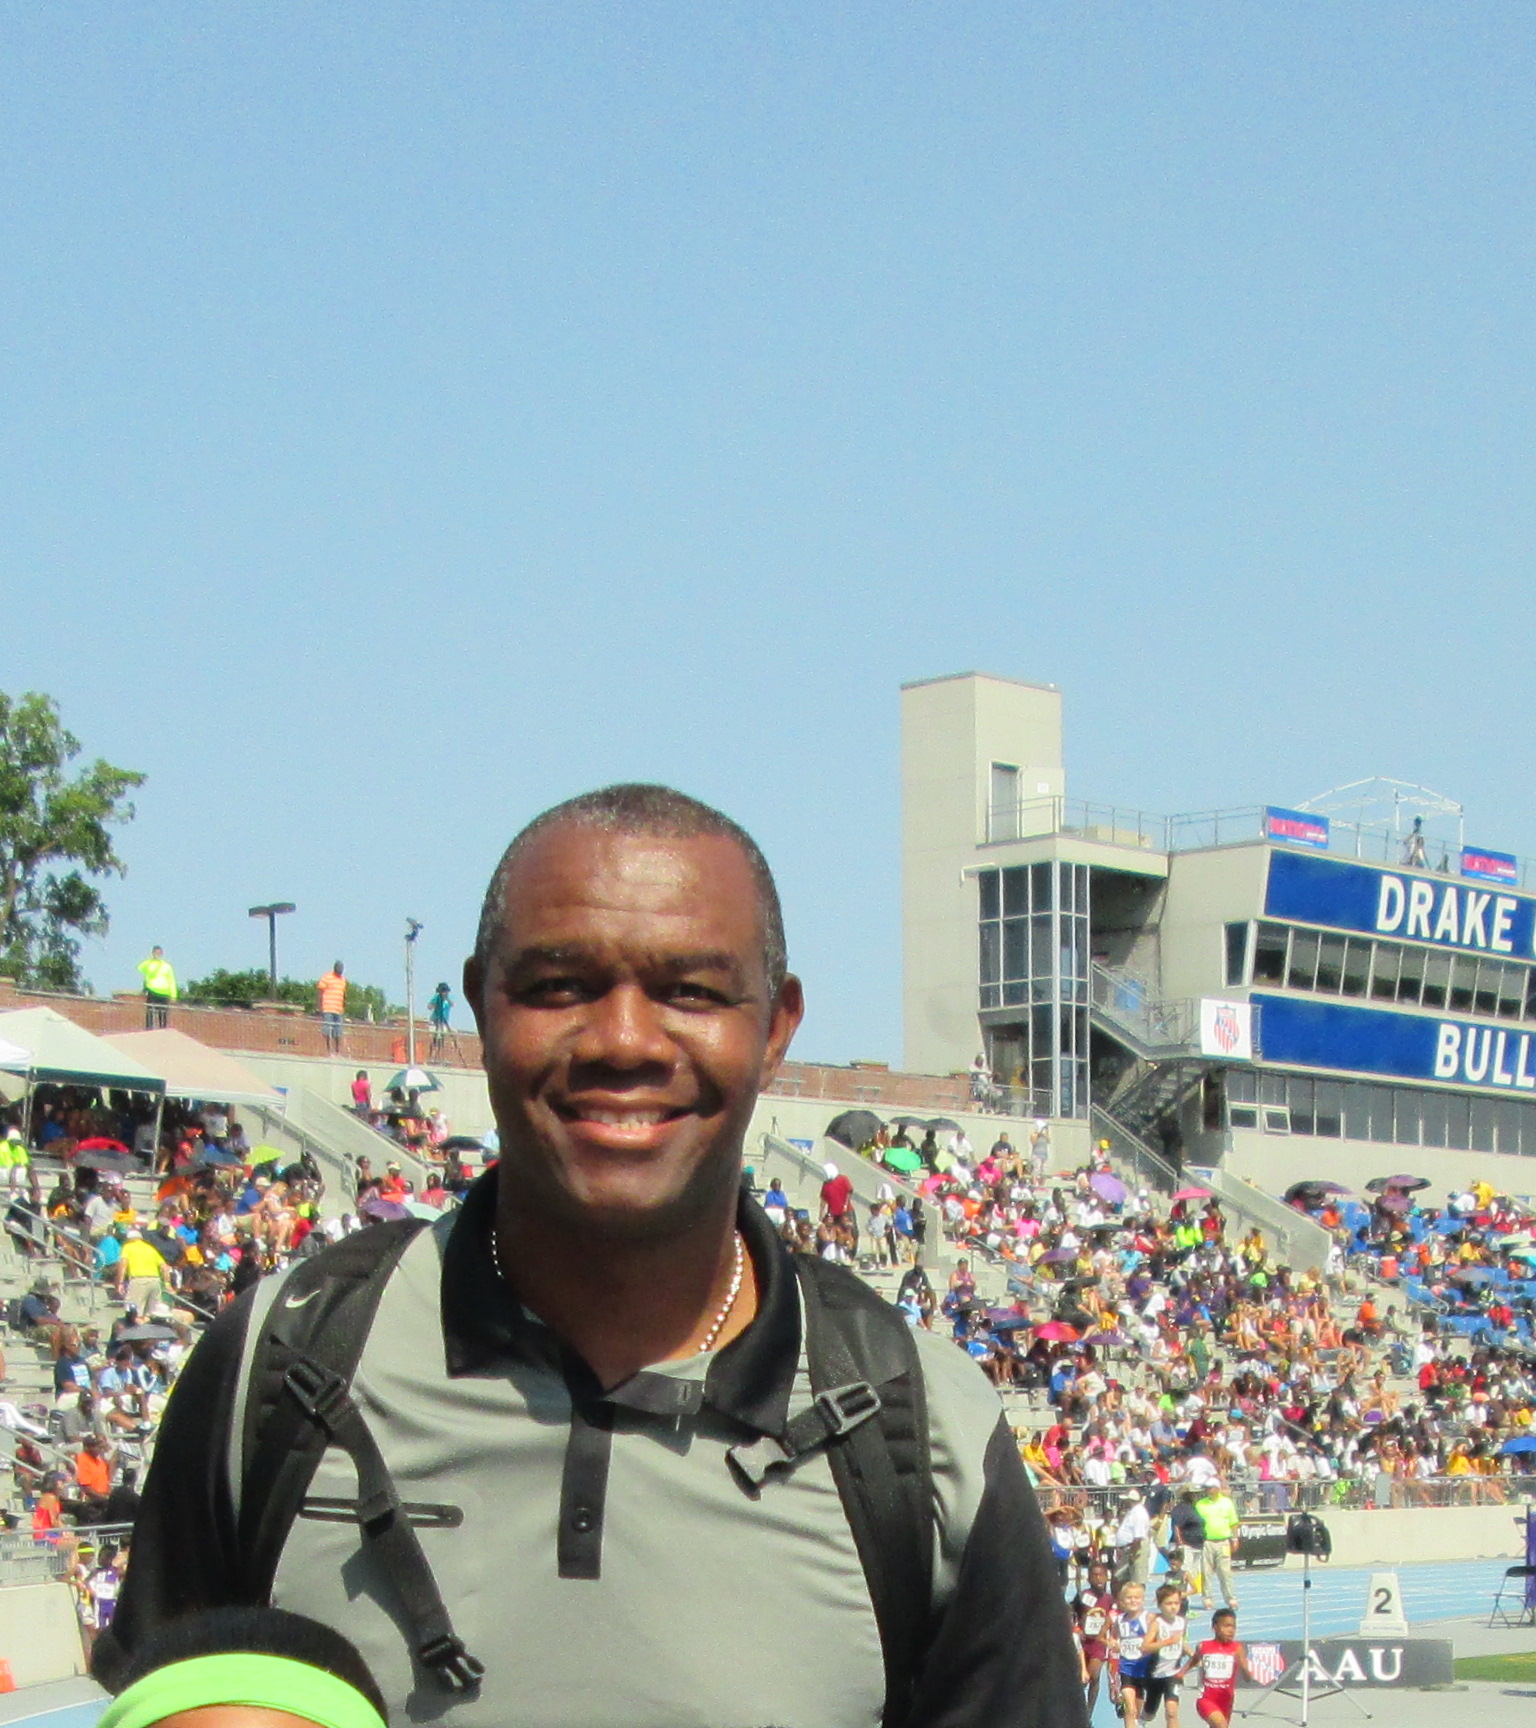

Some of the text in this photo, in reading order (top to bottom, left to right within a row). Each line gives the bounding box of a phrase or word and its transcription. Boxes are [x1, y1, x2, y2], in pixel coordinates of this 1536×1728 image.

[1377, 875, 1515, 954] DRAKE
[1373, 1587, 1392, 1615] 2
[1295, 1647, 1404, 1682] AAU
